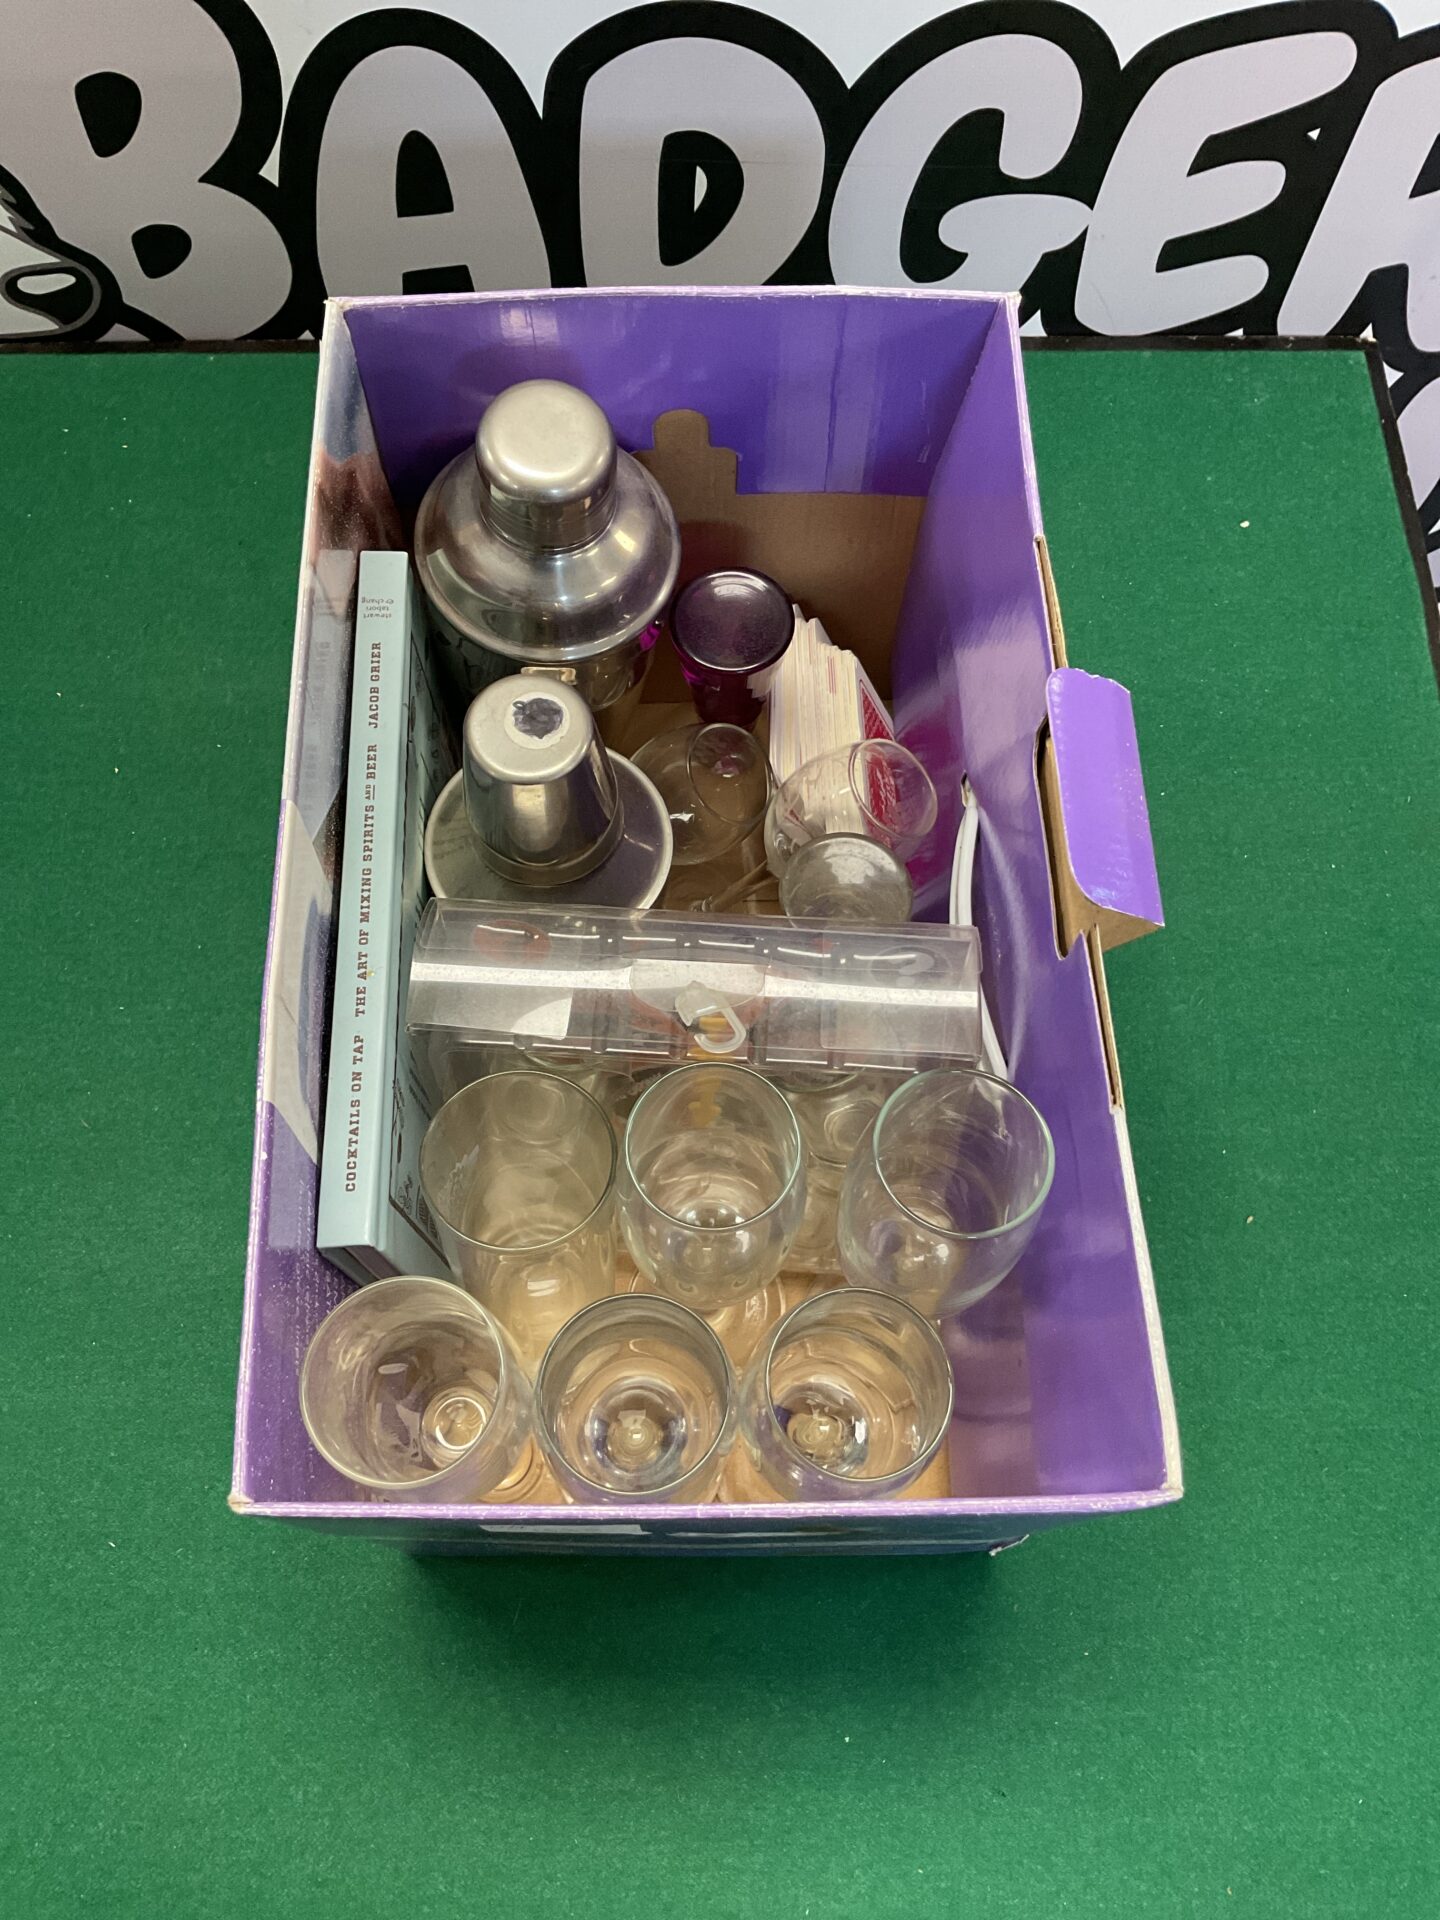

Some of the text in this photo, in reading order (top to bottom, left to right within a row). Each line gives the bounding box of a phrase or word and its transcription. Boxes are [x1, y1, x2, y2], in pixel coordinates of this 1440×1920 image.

[361, 597, 384, 605] chang
[369, 642, 381, 729] JACOB GRIER
[345, 744, 377, 1192] COCKTAILS ON TAP THE ART OF MIXING SPIRITS AND BEER
